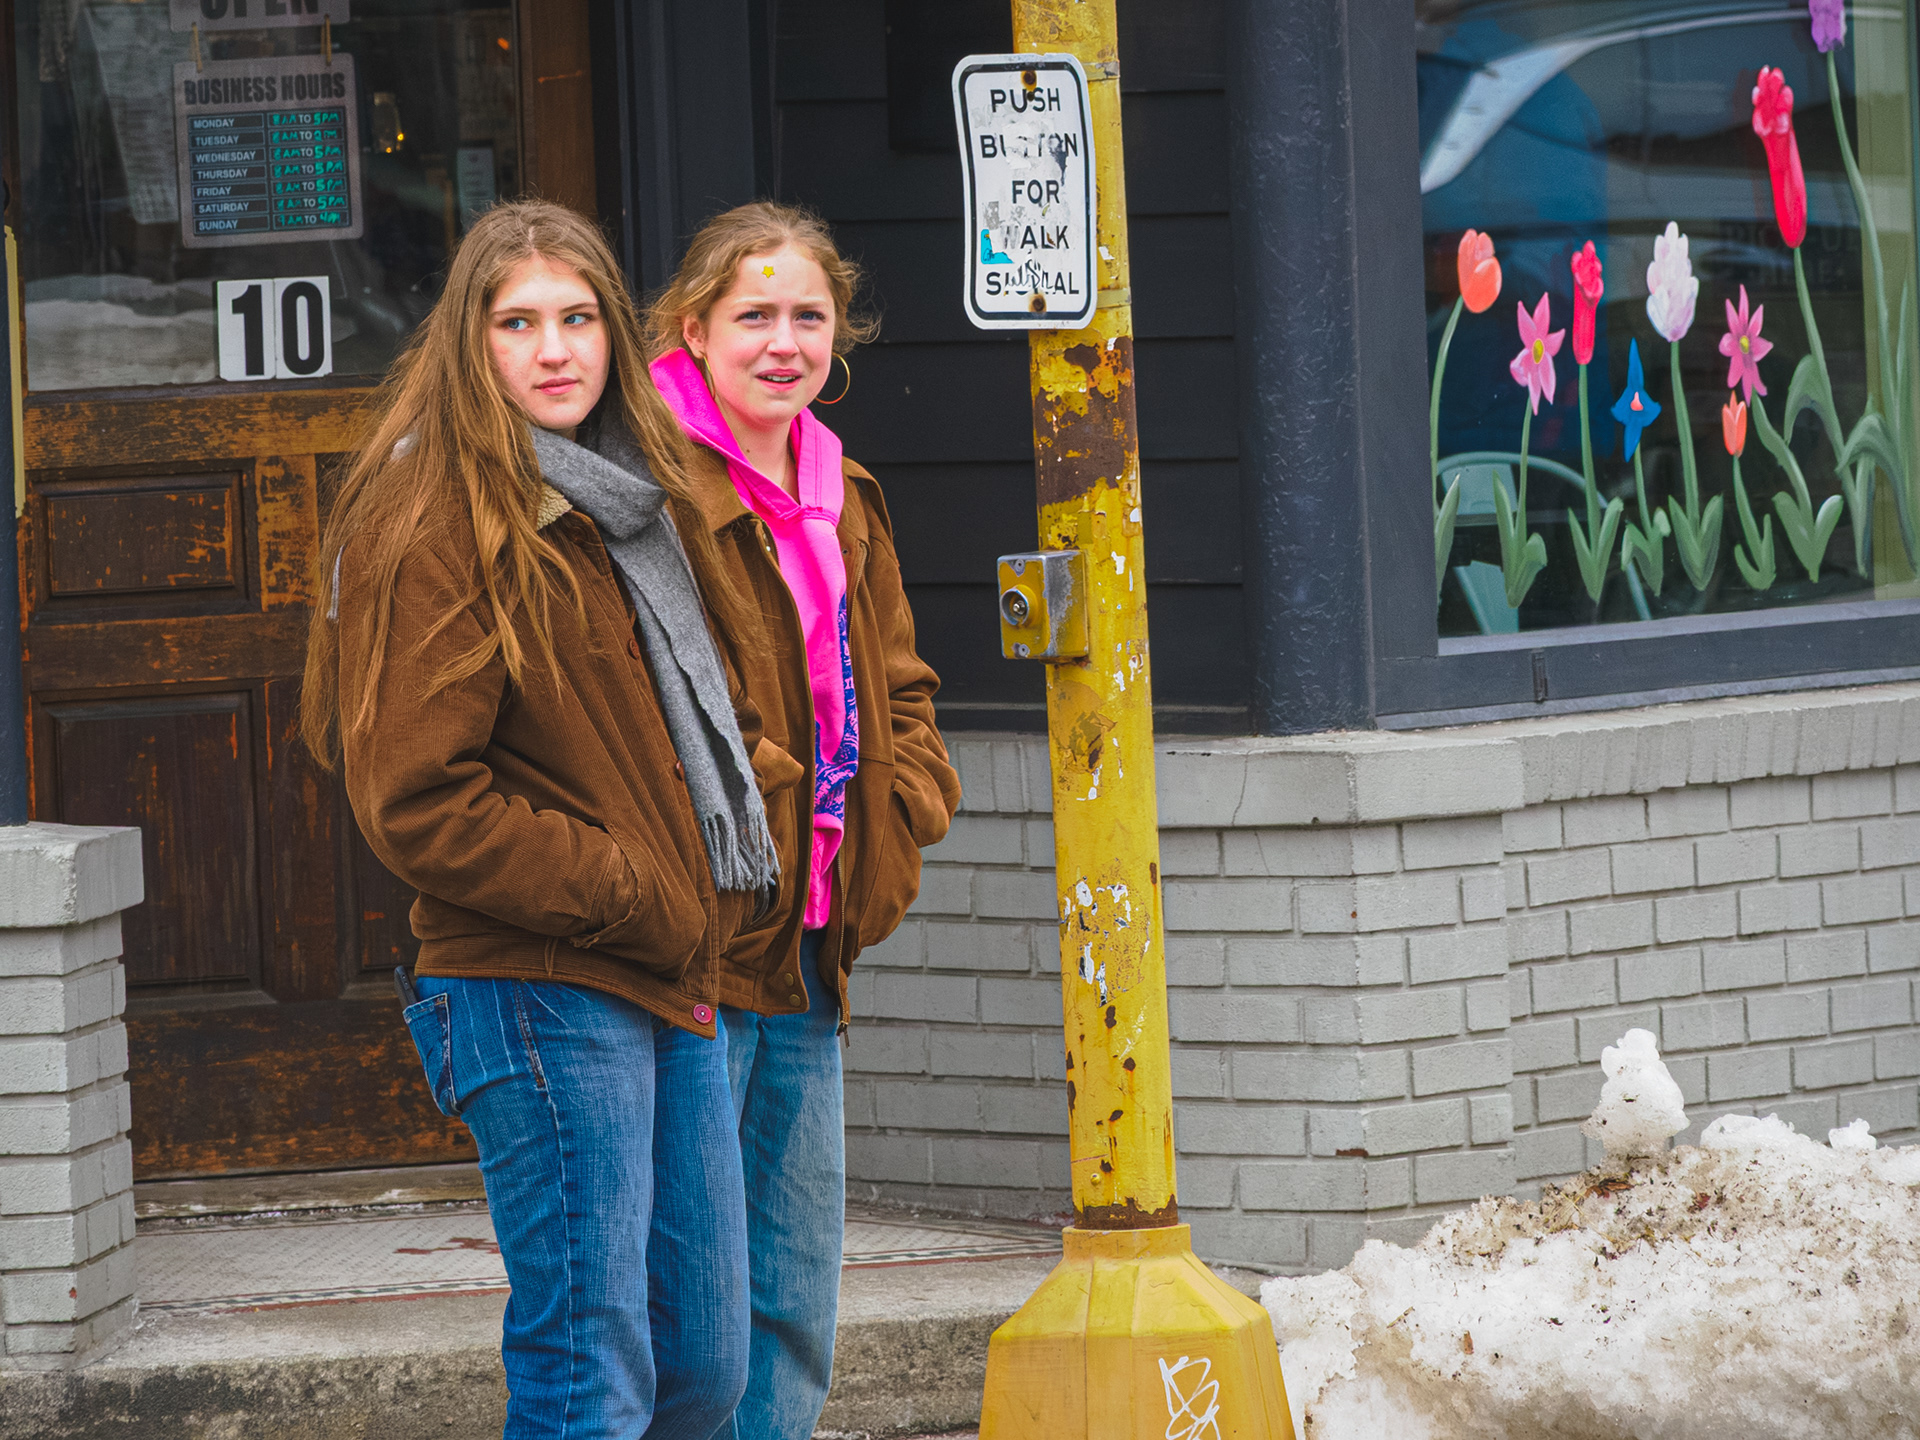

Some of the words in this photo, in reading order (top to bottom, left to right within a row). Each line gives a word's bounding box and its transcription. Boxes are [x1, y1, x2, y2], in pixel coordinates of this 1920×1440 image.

[184, 77, 277, 105] BUSINESS
[281, 72, 346, 100] HOURS
[990, 86, 1061, 113] PUSH
[193, 118, 235, 129] MONDAY
[298, 114, 311, 124] TO
[195, 135, 240, 146] TUESDAY
[299, 131, 312, 140] TO
[196, 151, 256, 163] WEDNESDAY
[301, 148, 313, 157] TO
[197, 168, 248, 180] THURSDAY
[301, 165, 314, 174] TO
[197, 186, 232, 197] FRIDAY
[302, 182, 315, 190] TO
[1012, 179, 1060, 204] FOR
[198, 202, 250, 214] SATURDAY
[303, 198, 316, 207] TO
[198, 219, 239, 231] SUNDAY
[304, 215, 317, 224] TO
[231, 281, 325, 376] 10
